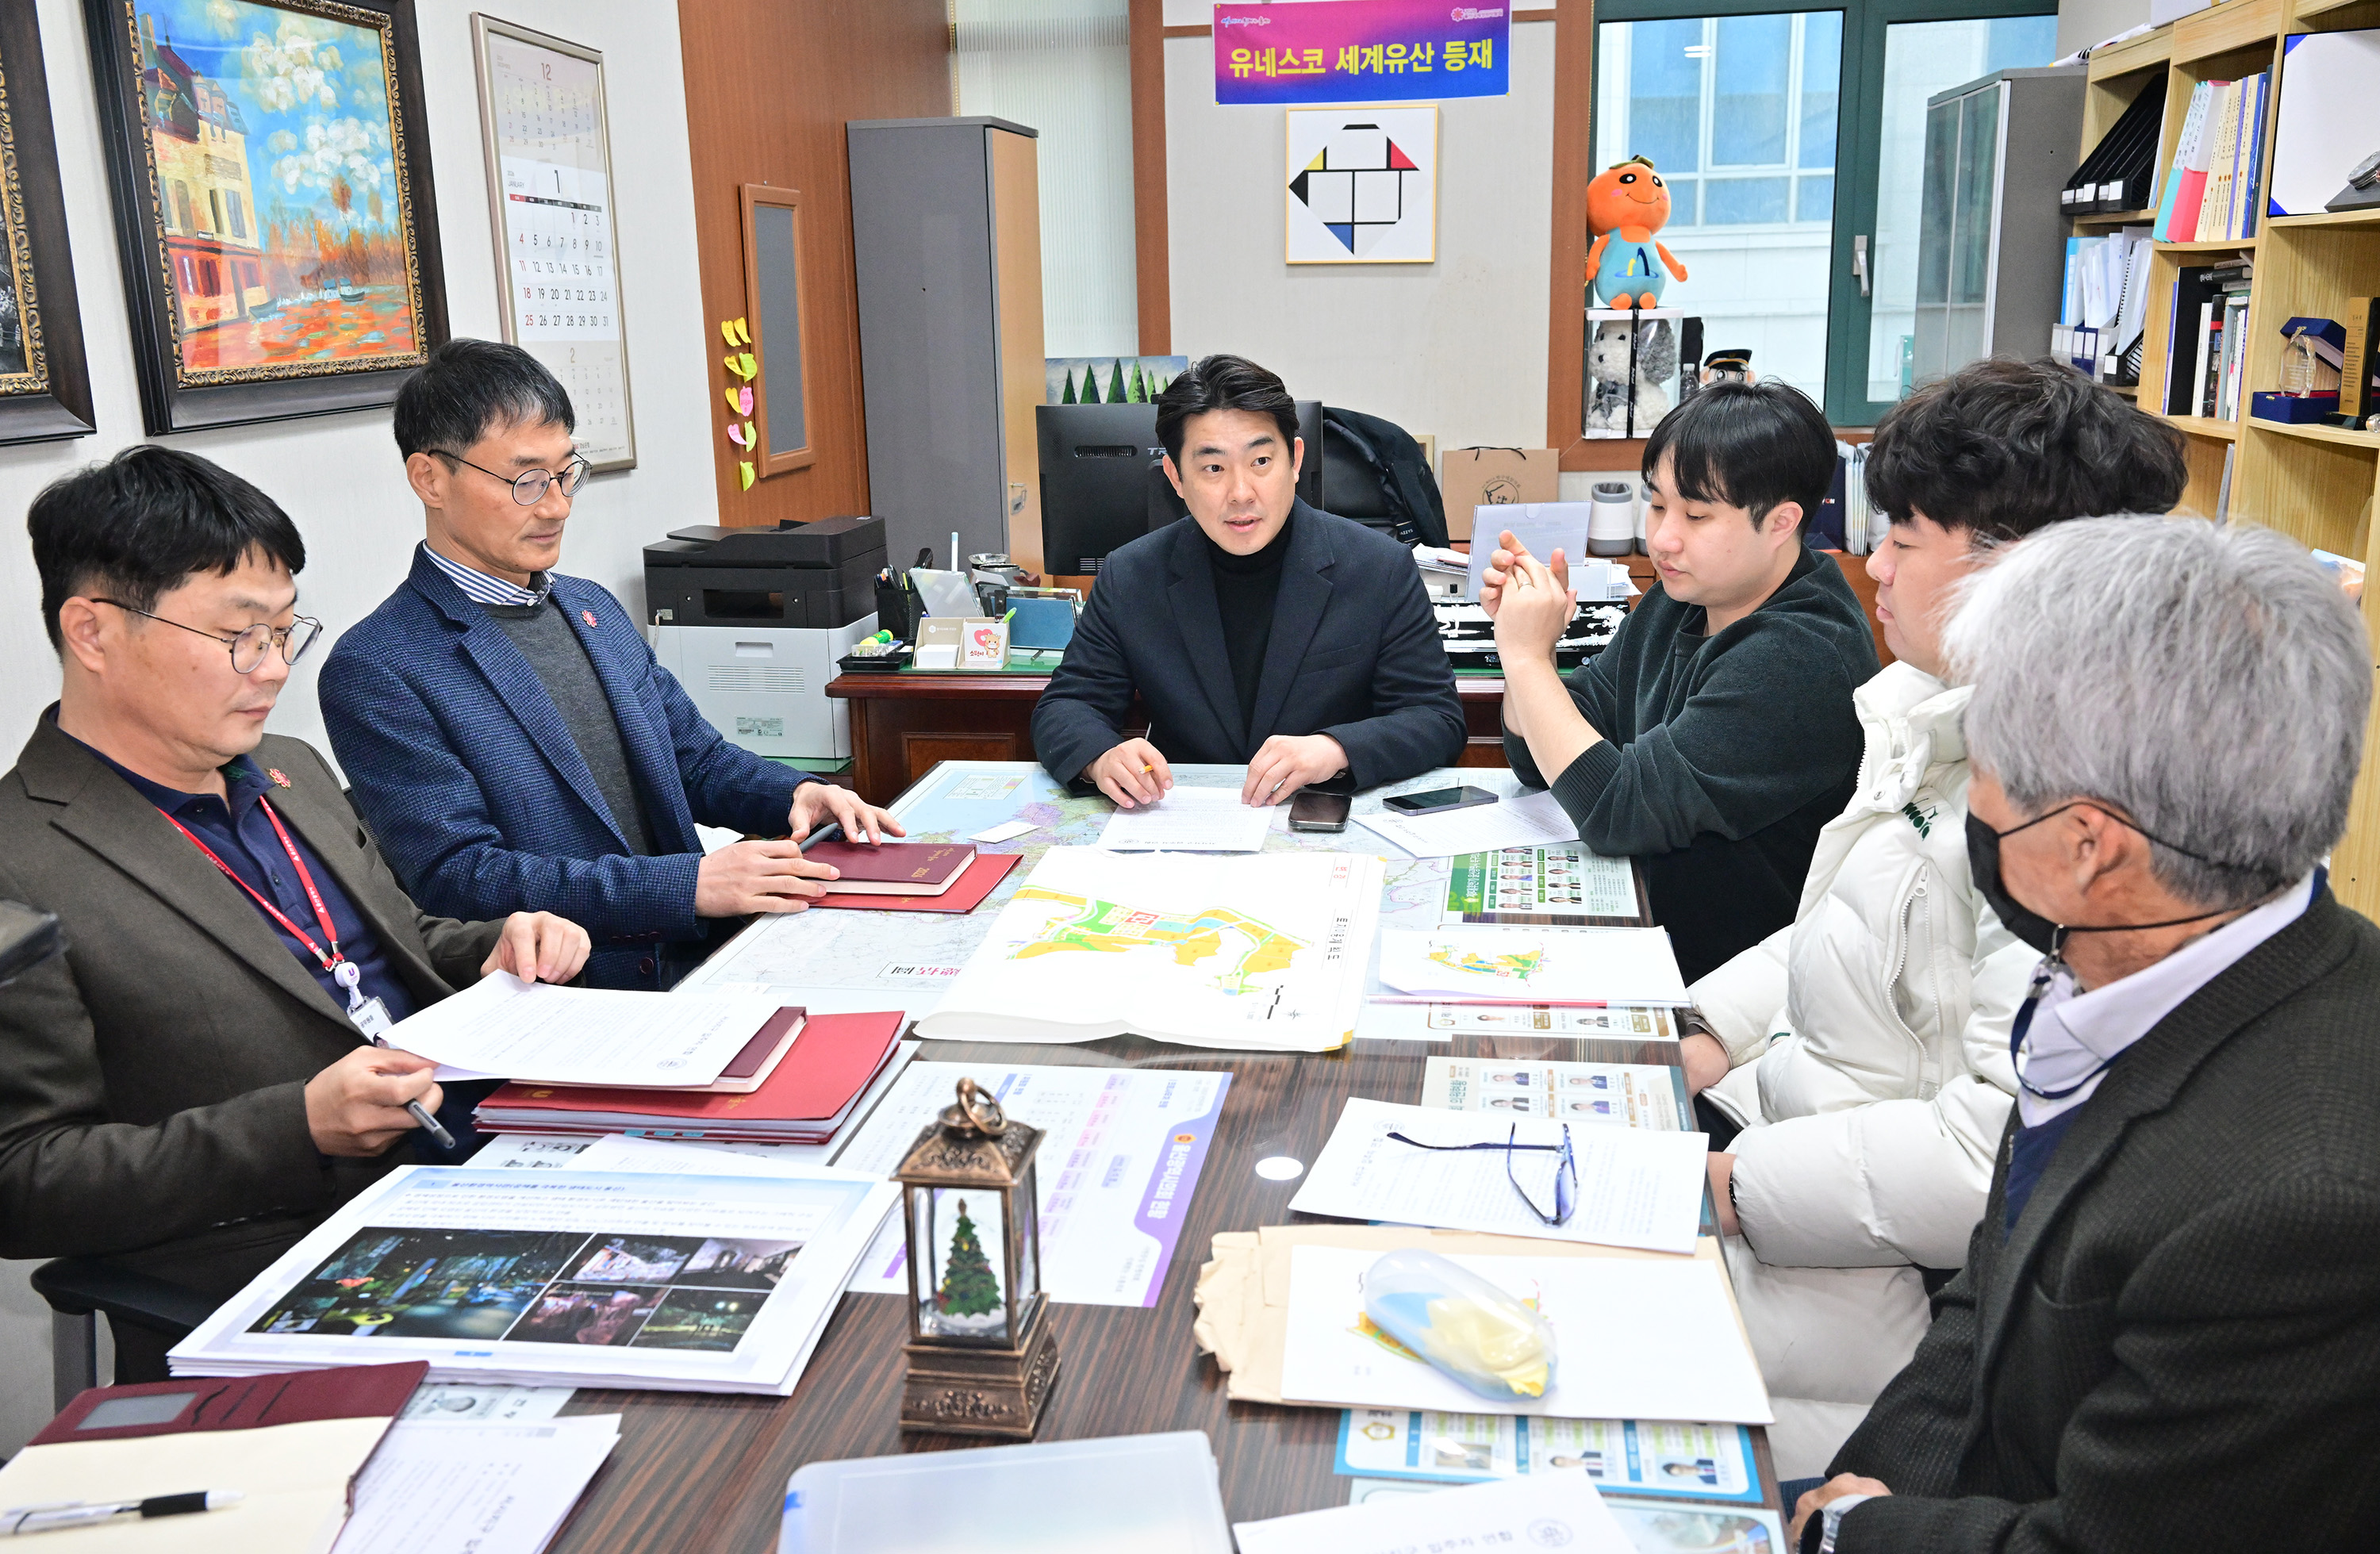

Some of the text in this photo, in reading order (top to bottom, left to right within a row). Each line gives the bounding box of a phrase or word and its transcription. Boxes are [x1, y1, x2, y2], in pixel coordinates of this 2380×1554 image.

[1229, 38, 1493, 78] 유네스코 세계유산 등재
[541, 63, 552, 81] 12
[554, 170, 560, 194] 1
[584, 213, 588, 224] 2
[596, 215, 600, 226] 3
[519, 233, 602, 251] 4 5 6 7 8 9 10
[519, 260, 603, 277] 11 12 13 14 15 16 17
[523, 287, 608, 301] 18 19 20 21 22 23 24
[525, 314, 608, 327] 25 26 27 28 29 30 31
[570, 347, 576, 363] 2
[1326, 916, 1349, 961] 토지이용계획도
